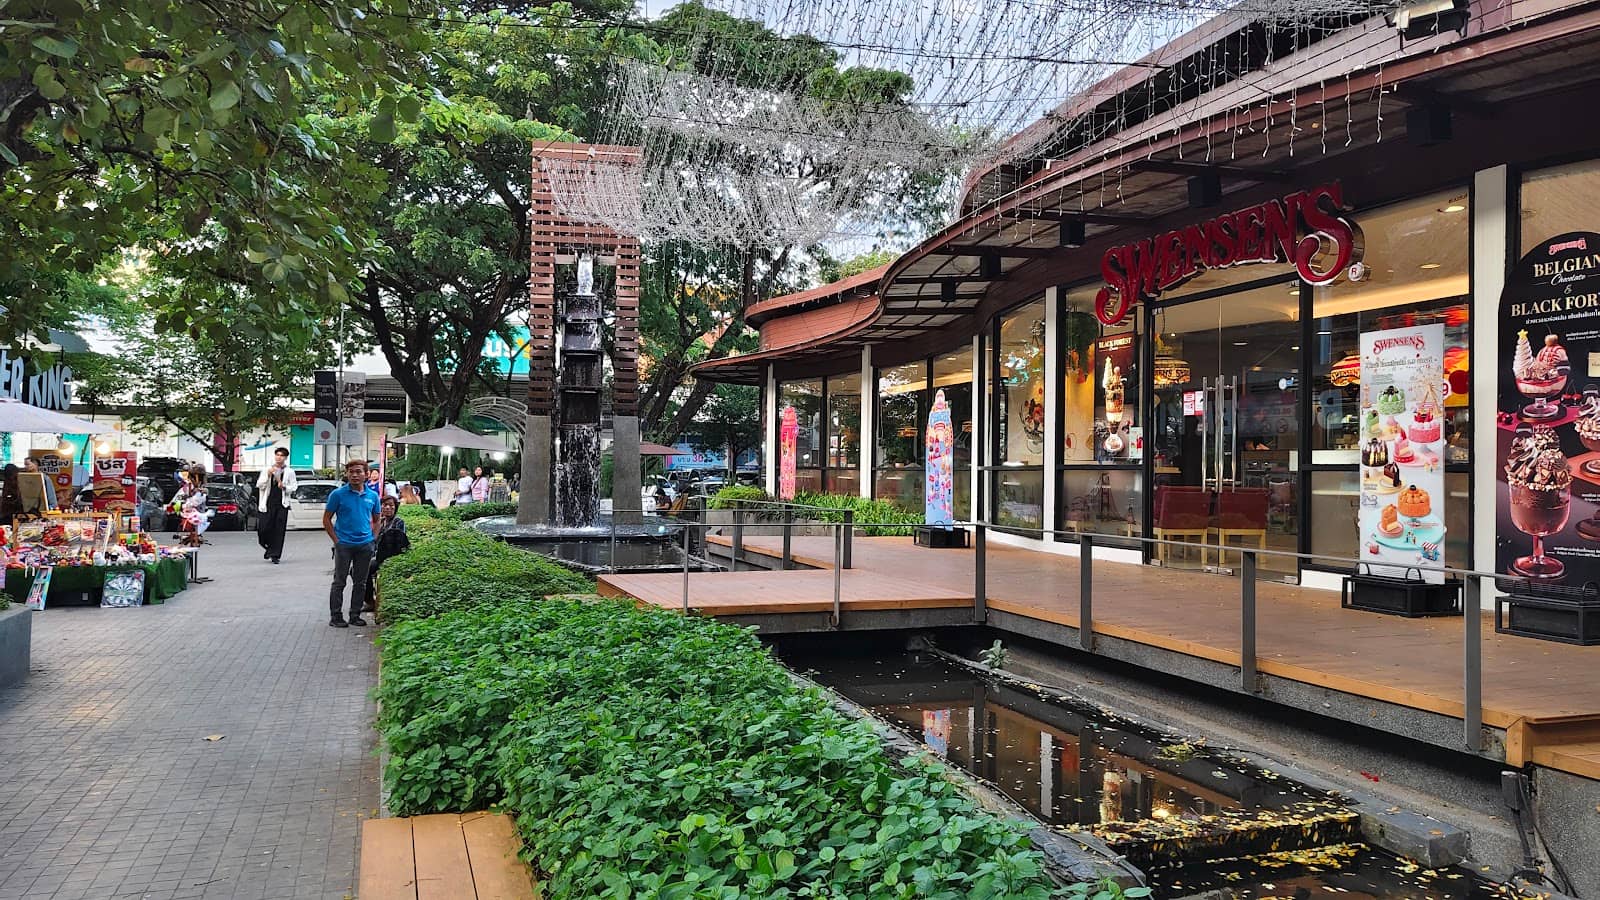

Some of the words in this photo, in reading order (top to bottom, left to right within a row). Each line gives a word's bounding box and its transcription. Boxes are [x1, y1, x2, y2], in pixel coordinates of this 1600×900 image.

[1095, 181, 1355, 327] SWENSEN'S
[1511, 297, 1562, 317] BLACK
[1565, 292, 1600, 310] FOR
[1373, 335, 1425, 355] SWENSEN'S
[29, 360, 72, 411] KING
